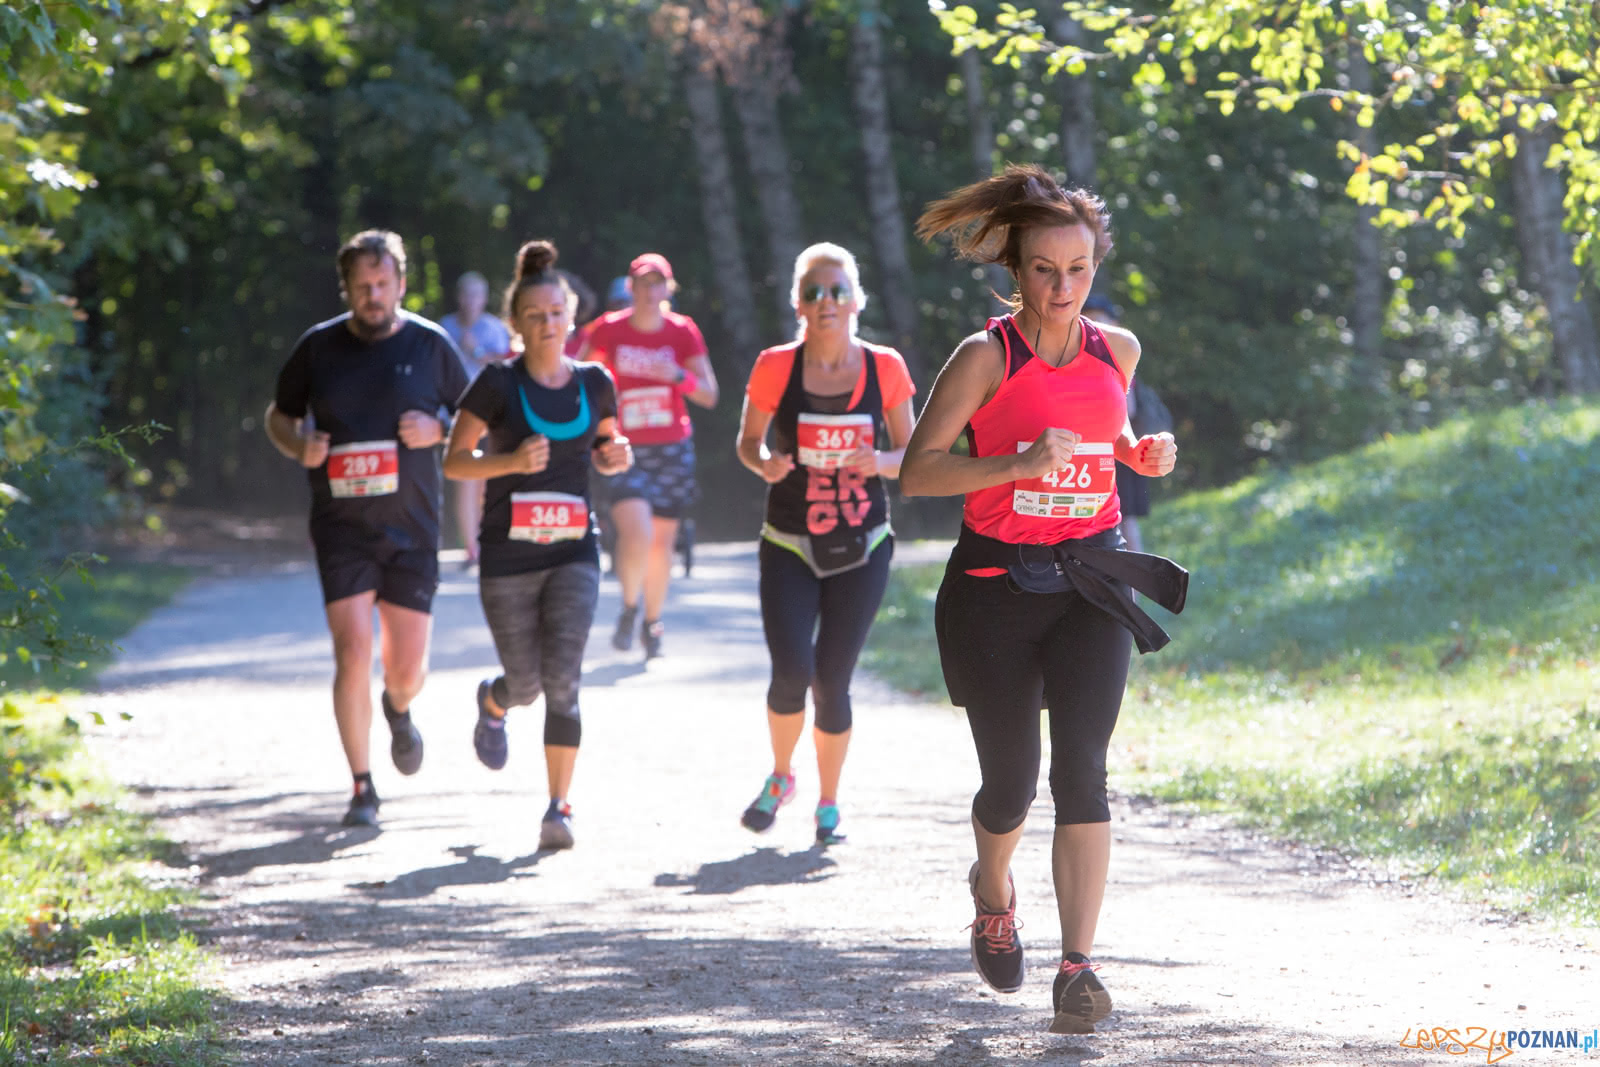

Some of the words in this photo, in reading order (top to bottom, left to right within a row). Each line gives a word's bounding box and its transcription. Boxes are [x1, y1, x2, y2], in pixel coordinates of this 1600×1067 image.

[816, 429, 855, 448] 369
[343, 455, 380, 476] 289
[1042, 463, 1092, 488] 426
[530, 505, 570, 526] 368
